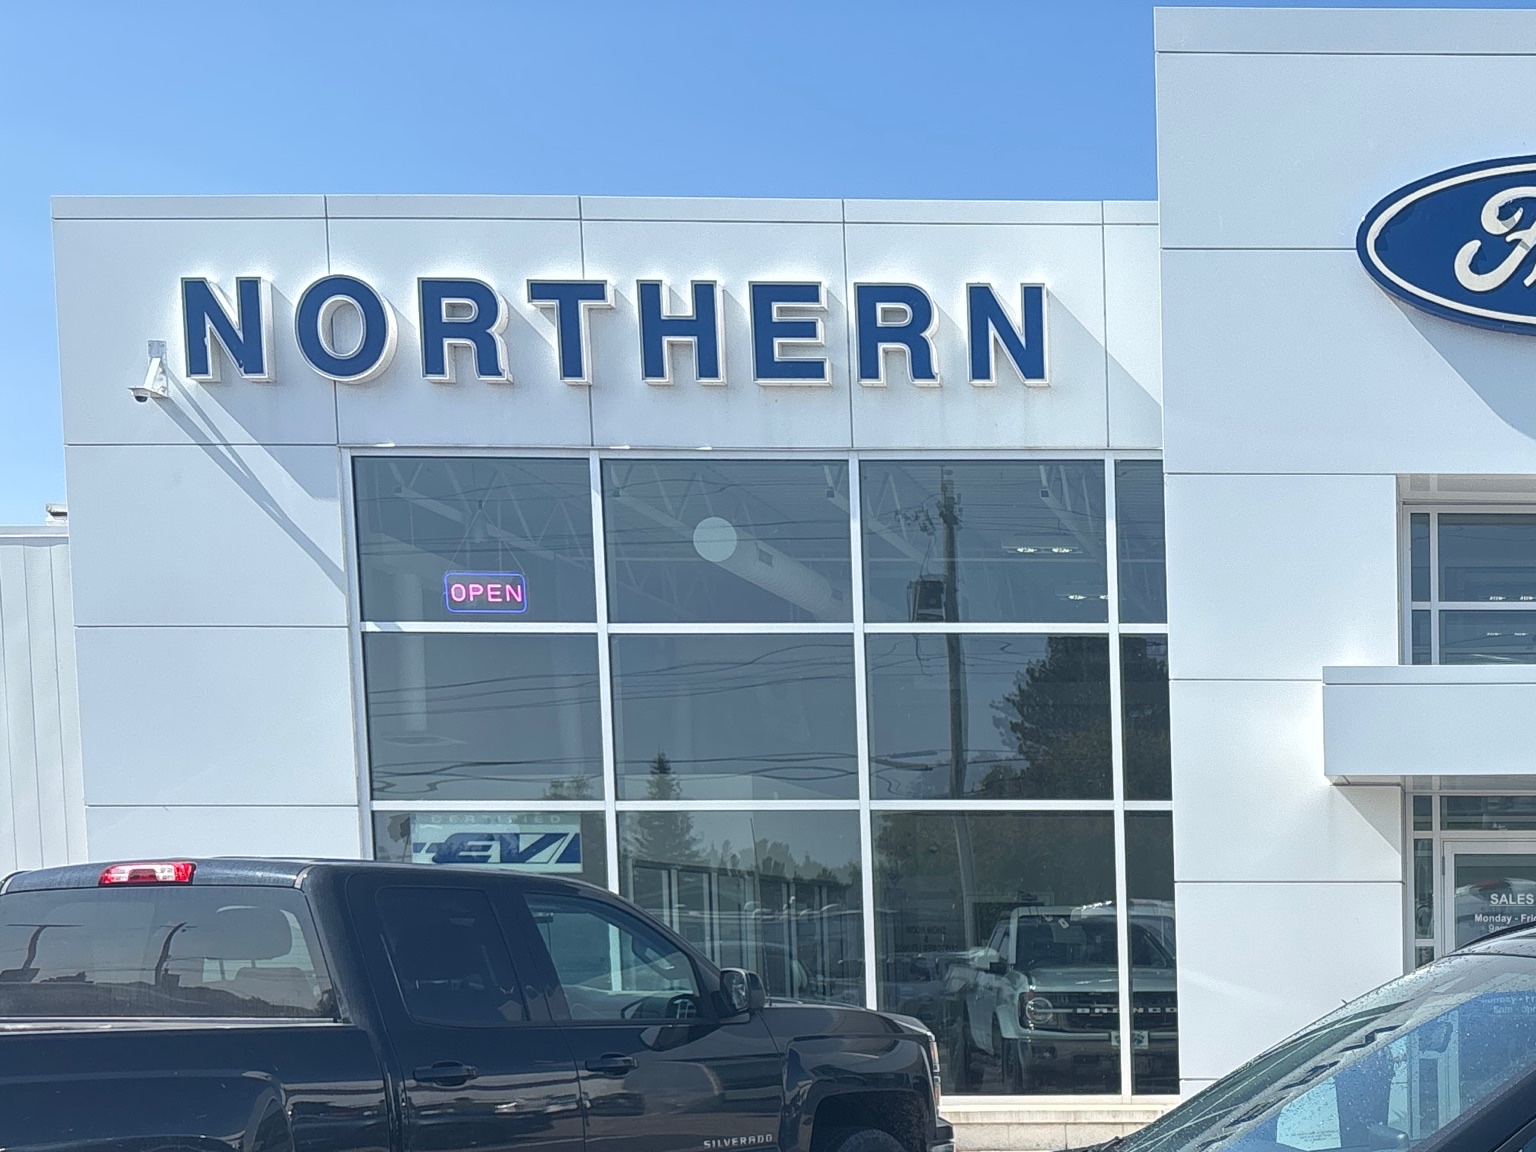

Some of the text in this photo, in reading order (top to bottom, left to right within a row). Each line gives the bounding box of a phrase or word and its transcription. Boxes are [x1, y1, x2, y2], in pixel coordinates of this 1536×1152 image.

[180, 274, 1050, 387] NORTHERN
[450, 583, 522, 602] OPEN
[431, 814, 561, 824] CERTIFIED
[432, 833, 570, 864] EV
[1490, 893, 1535, 905] SALES
[1474, 914, 1512, 924] Monday
[703, 1134, 773, 1149] SILVERADO
